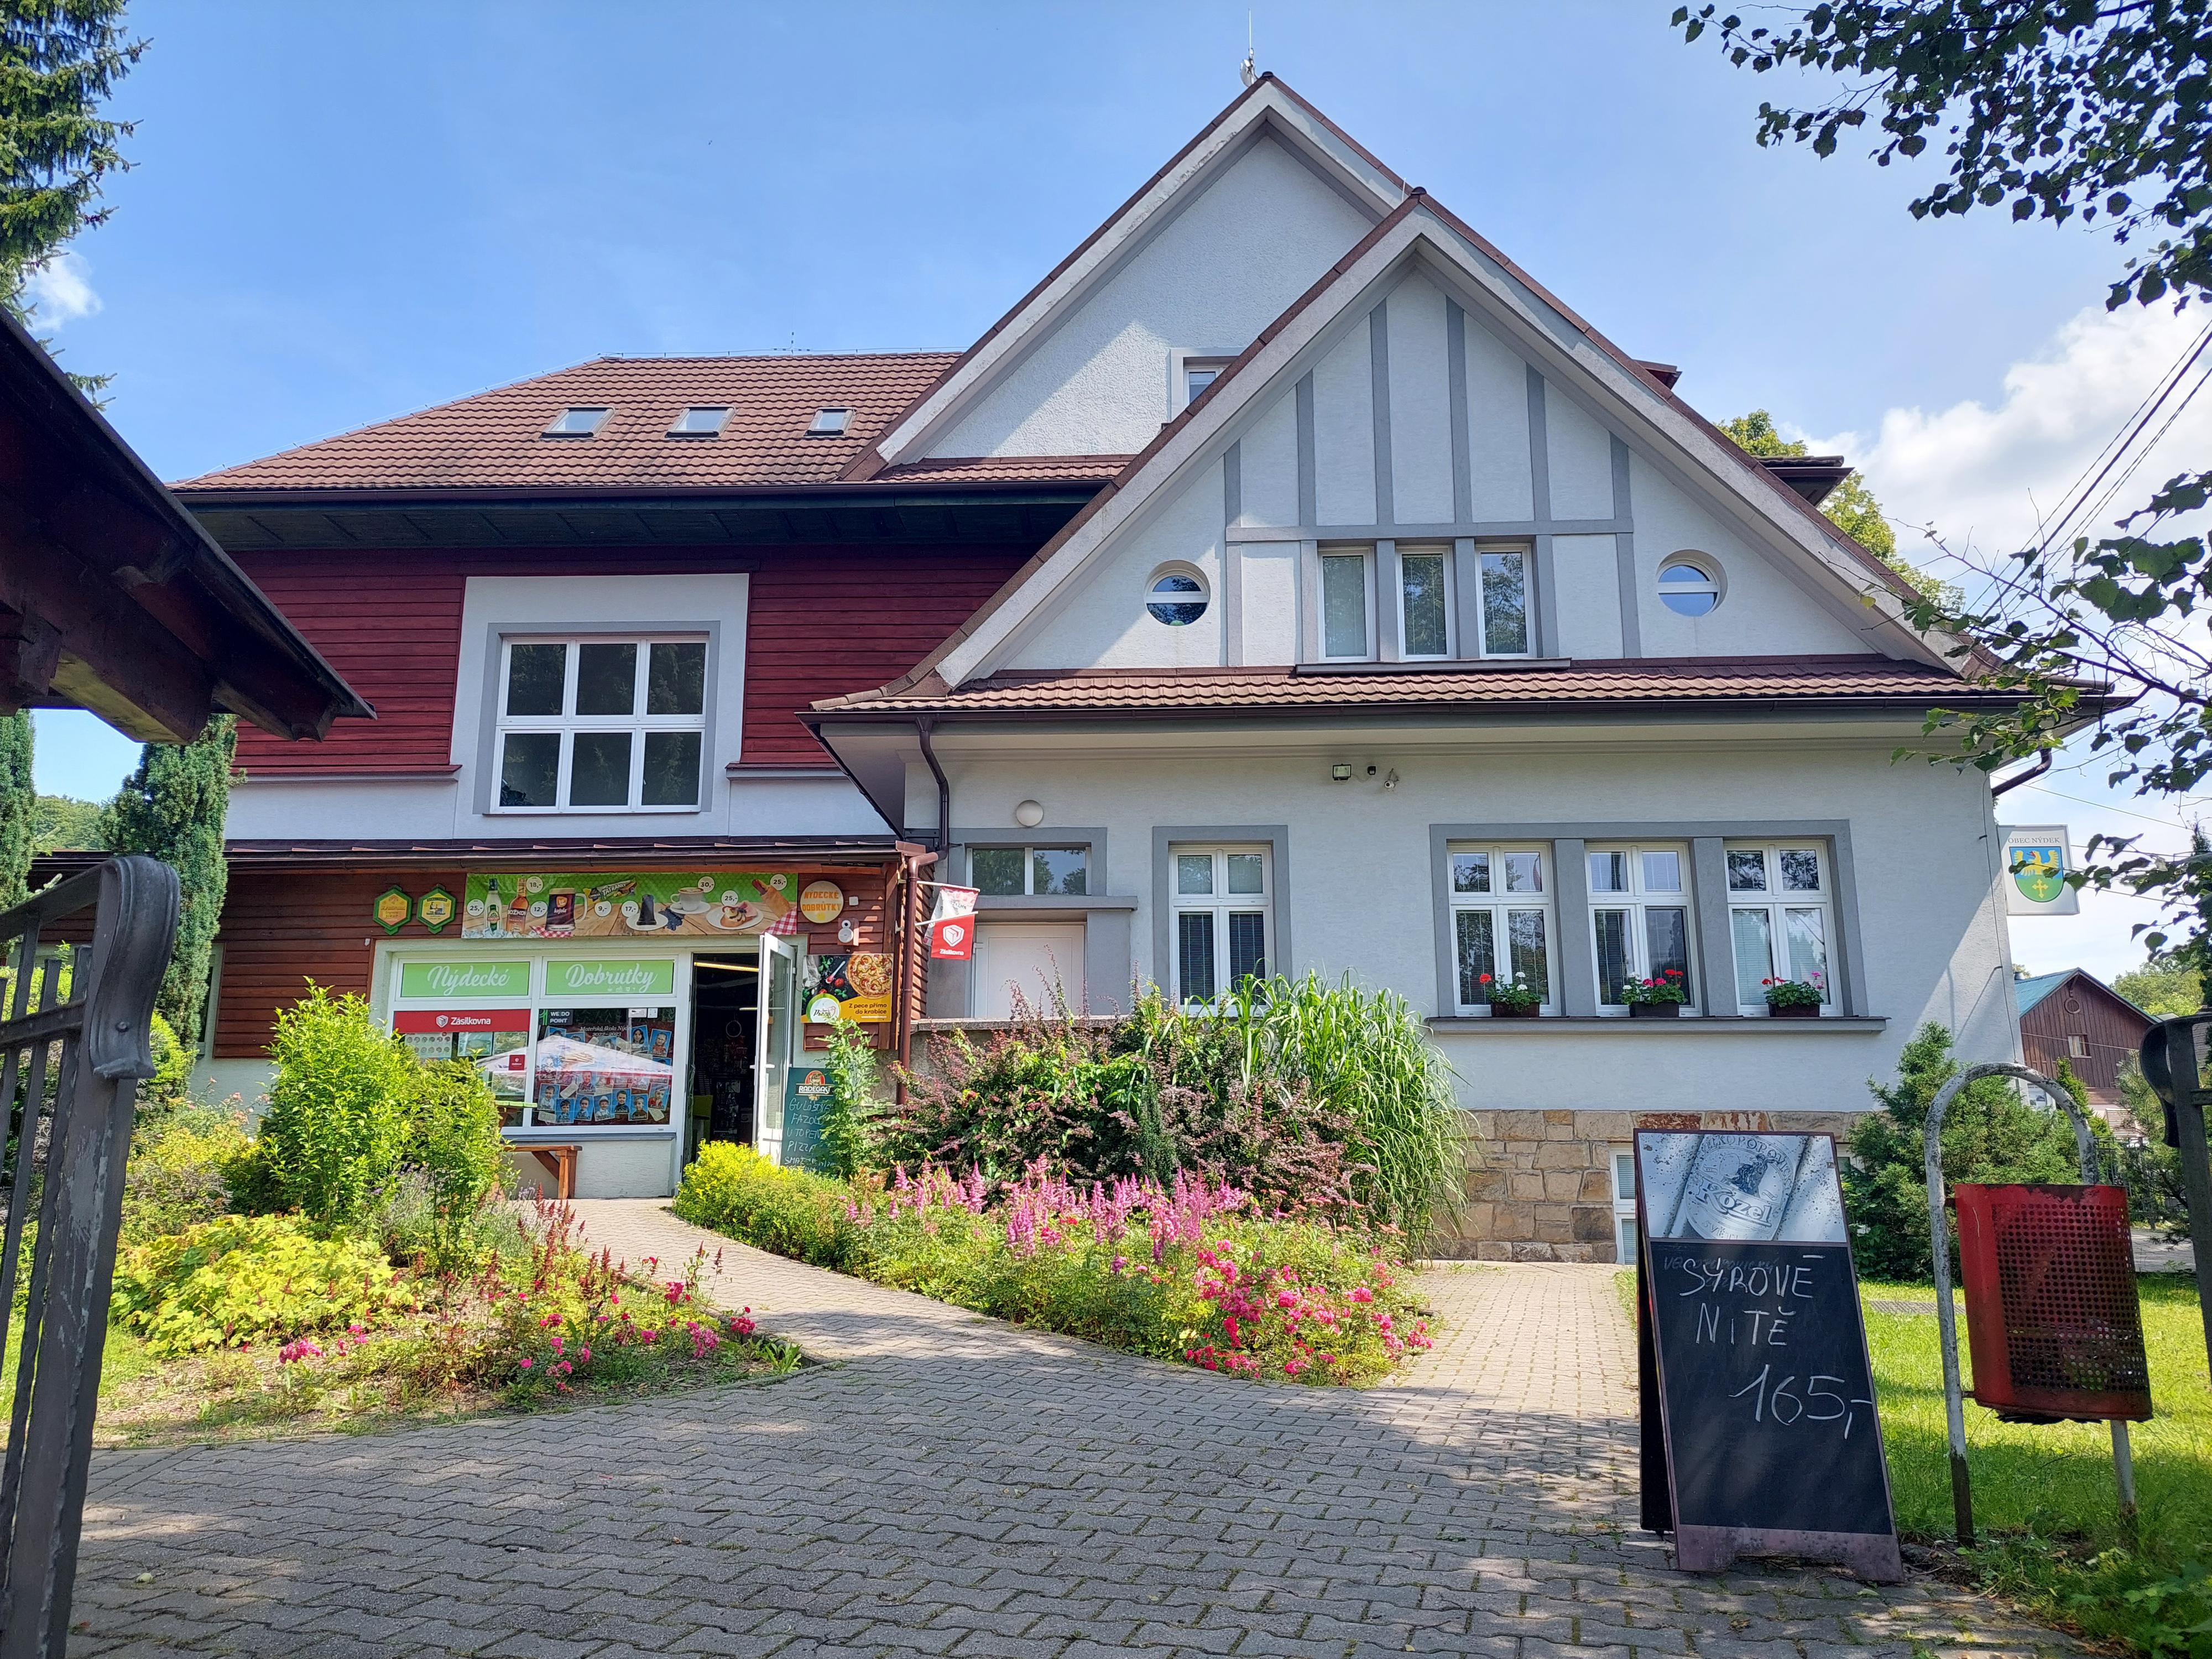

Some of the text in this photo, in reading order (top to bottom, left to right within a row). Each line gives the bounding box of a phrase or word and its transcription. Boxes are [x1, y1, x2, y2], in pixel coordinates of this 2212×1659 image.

[427, 965, 510, 995] Nýdecké
[450, 1016, 491, 1025] Zásilkovna
[1695, 1177, 1772, 1228] Kozel
[1695, 1302, 1796, 1345] NITĚ
[1728, 1364, 1872, 1440] 165,-
